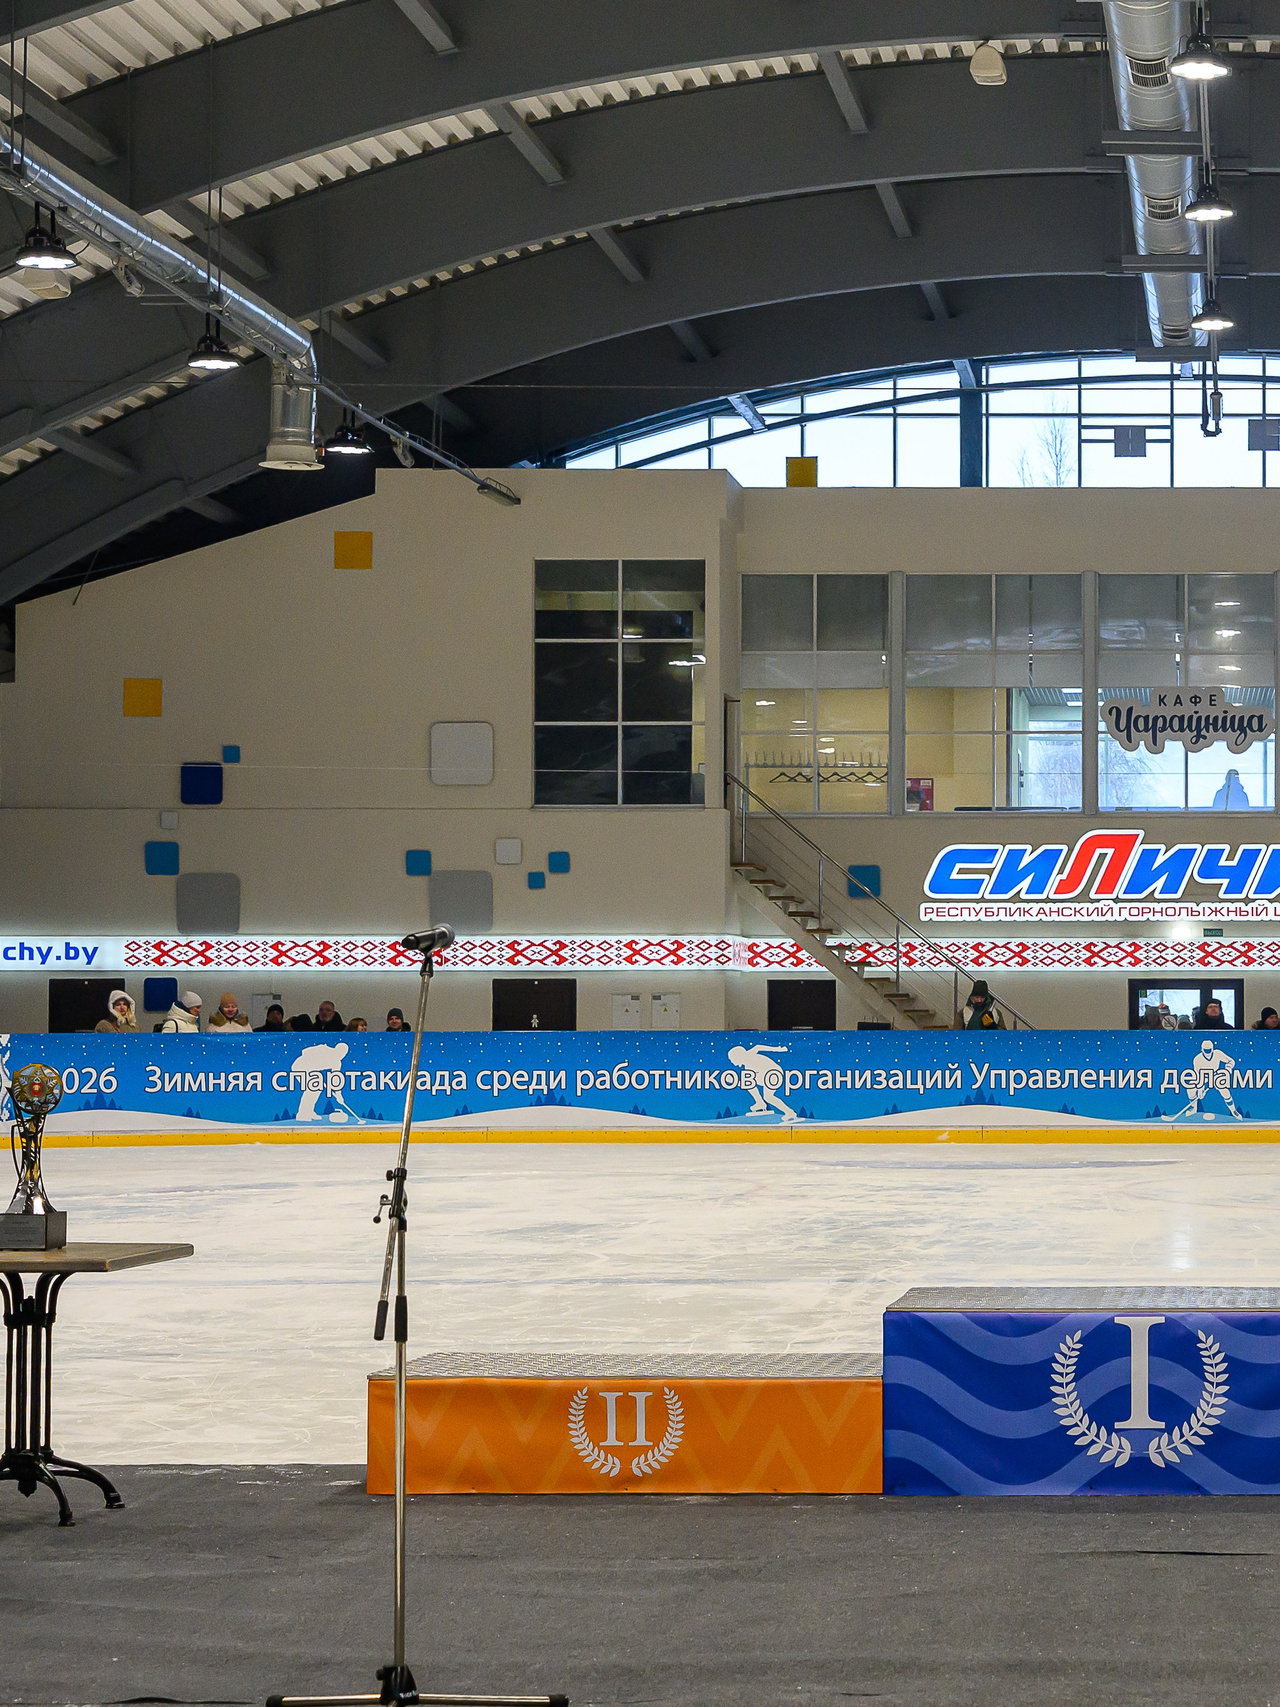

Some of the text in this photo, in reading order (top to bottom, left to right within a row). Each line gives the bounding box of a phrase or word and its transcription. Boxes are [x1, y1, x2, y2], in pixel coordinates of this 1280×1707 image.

[1158, 694, 1217, 707] КАФЕ
[1108, 705, 1268, 747] Чараўніца
[923, 904, 1114, 918] РЕСПУБЛИКАНСКИЙ
[1118, 904, 1269, 918] ГОРНОЛЫЖНЫЙ
[2, 941, 99, 966] chy.by
[144, 1064, 262, 1094] Зимняя
[270, 1069, 468, 1099] спартакиада
[475, 1067, 567, 1098] среди
[576, 1062, 757, 1097] работников
[763, 1062, 963, 1095] организаций
[969, 1062, 1153, 1096] Управления
[1160, 1067, 1274, 1094] делами
[1113, 1316, 1166, 1430] I
[598, 1391, 653, 1447] II
